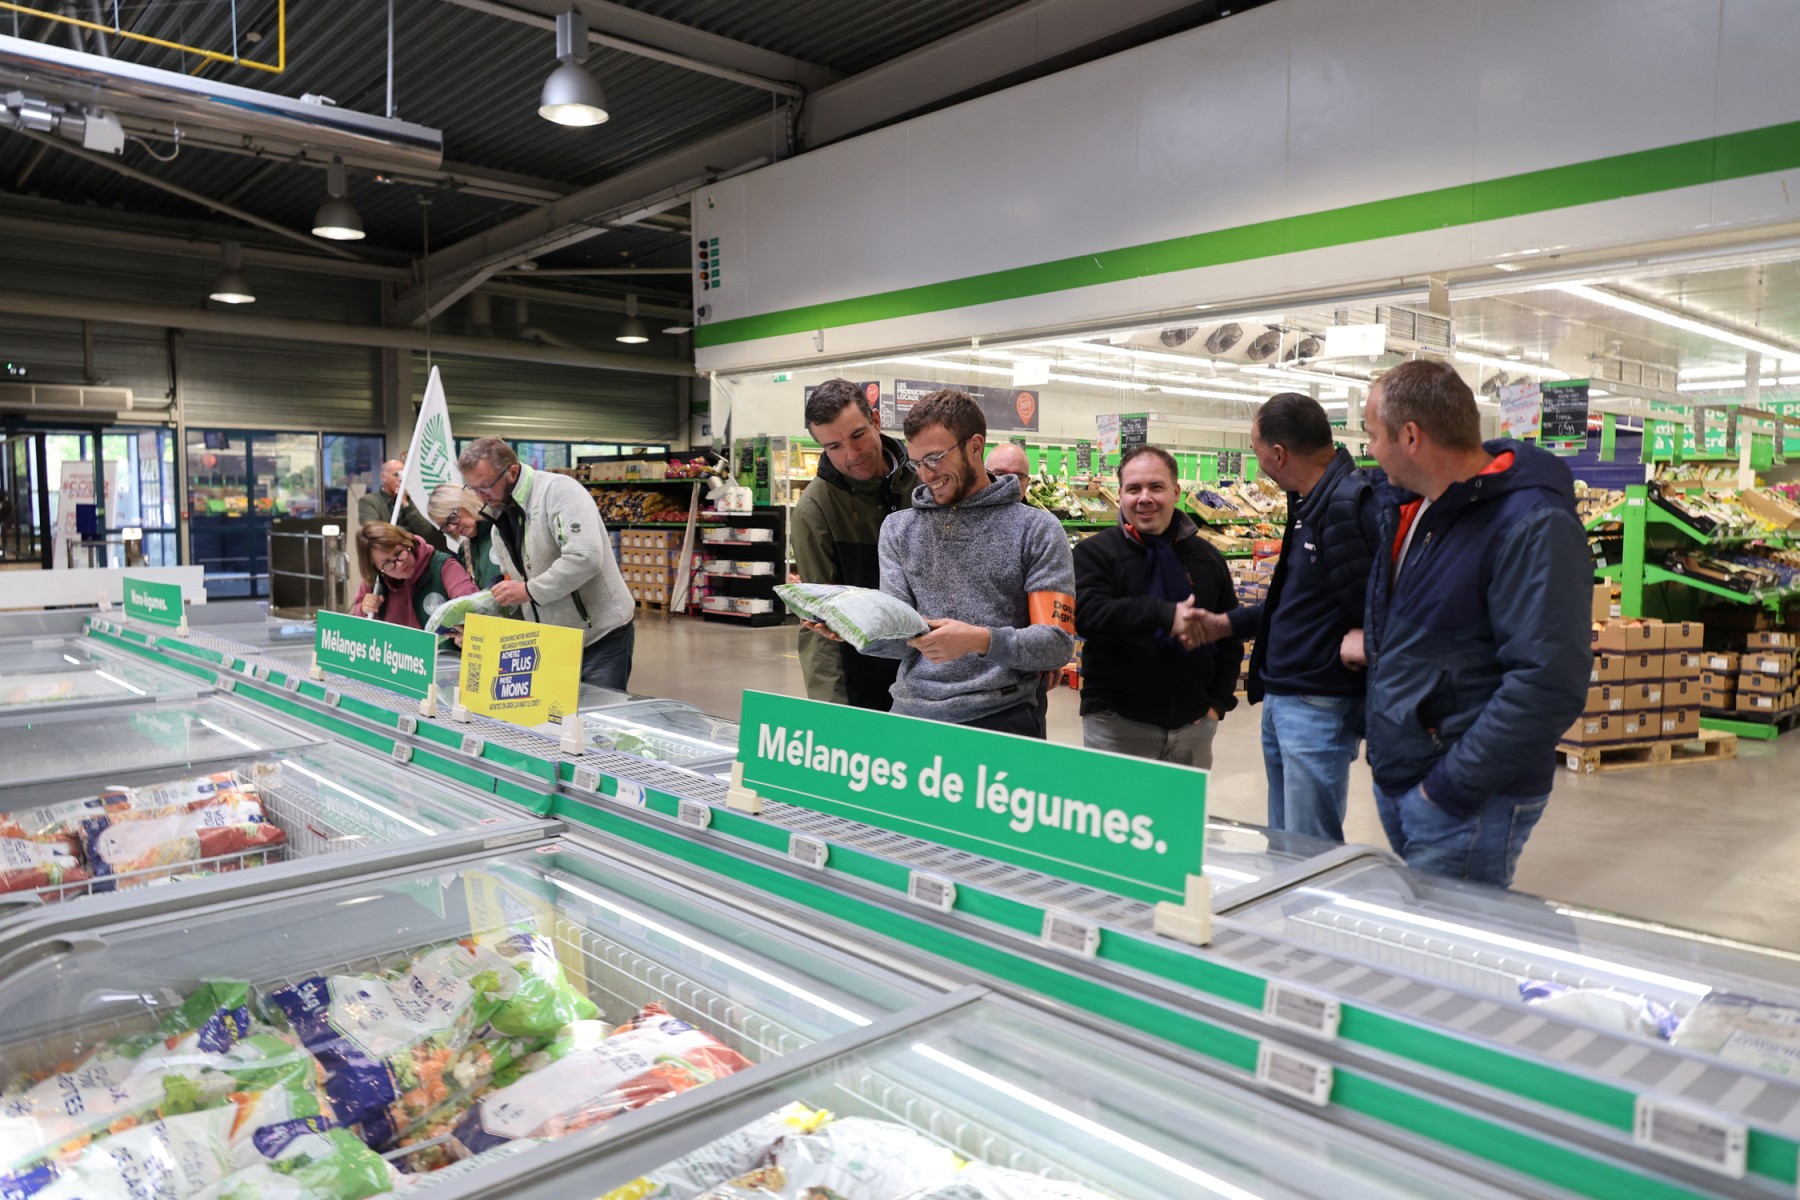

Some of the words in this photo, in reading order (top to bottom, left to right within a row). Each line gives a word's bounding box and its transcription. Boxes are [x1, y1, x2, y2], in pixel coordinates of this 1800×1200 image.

[321, 628, 367, 662] Mélanges
[368, 638, 381, 662] de
[383, 641, 427, 676] légumes.
[501, 650, 521, 659] ACHETEZ
[511, 656, 532, 672] PLUS
[499, 676, 513, 684] PAYEZ
[501, 681, 529, 698] MOINS
[757, 722, 908, 792] Mélanges
[918, 755, 964, 803] de
[975, 764, 1168, 854] légumes.
